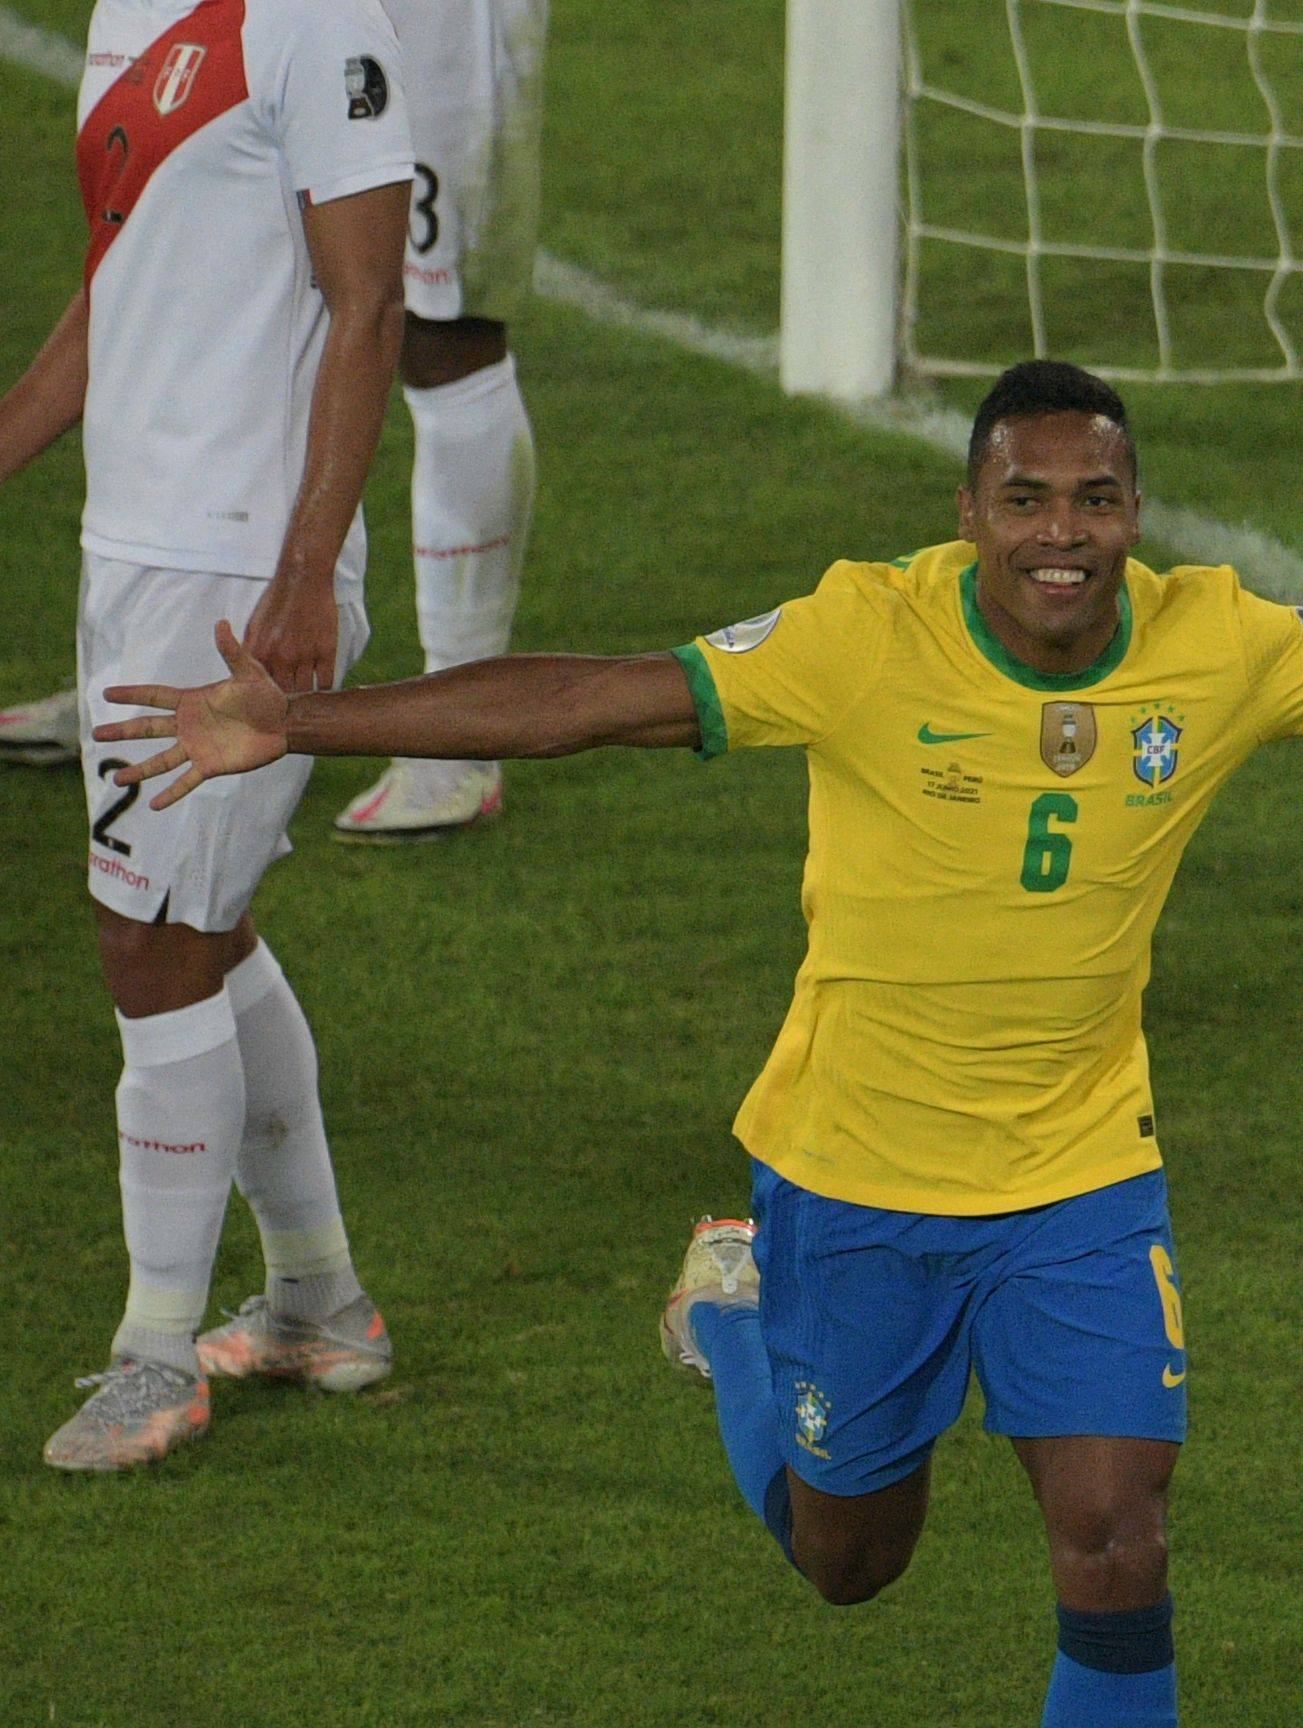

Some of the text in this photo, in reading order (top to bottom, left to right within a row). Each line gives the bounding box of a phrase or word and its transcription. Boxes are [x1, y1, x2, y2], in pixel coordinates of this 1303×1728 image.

[1125, 792, 1172, 807] BRASIL
[1147, 744, 1165, 755] CBF
[93, 757, 141, 857] 2
[1020, 792, 1078, 893] 6
[1149, 1245, 1185, 1349] 6
